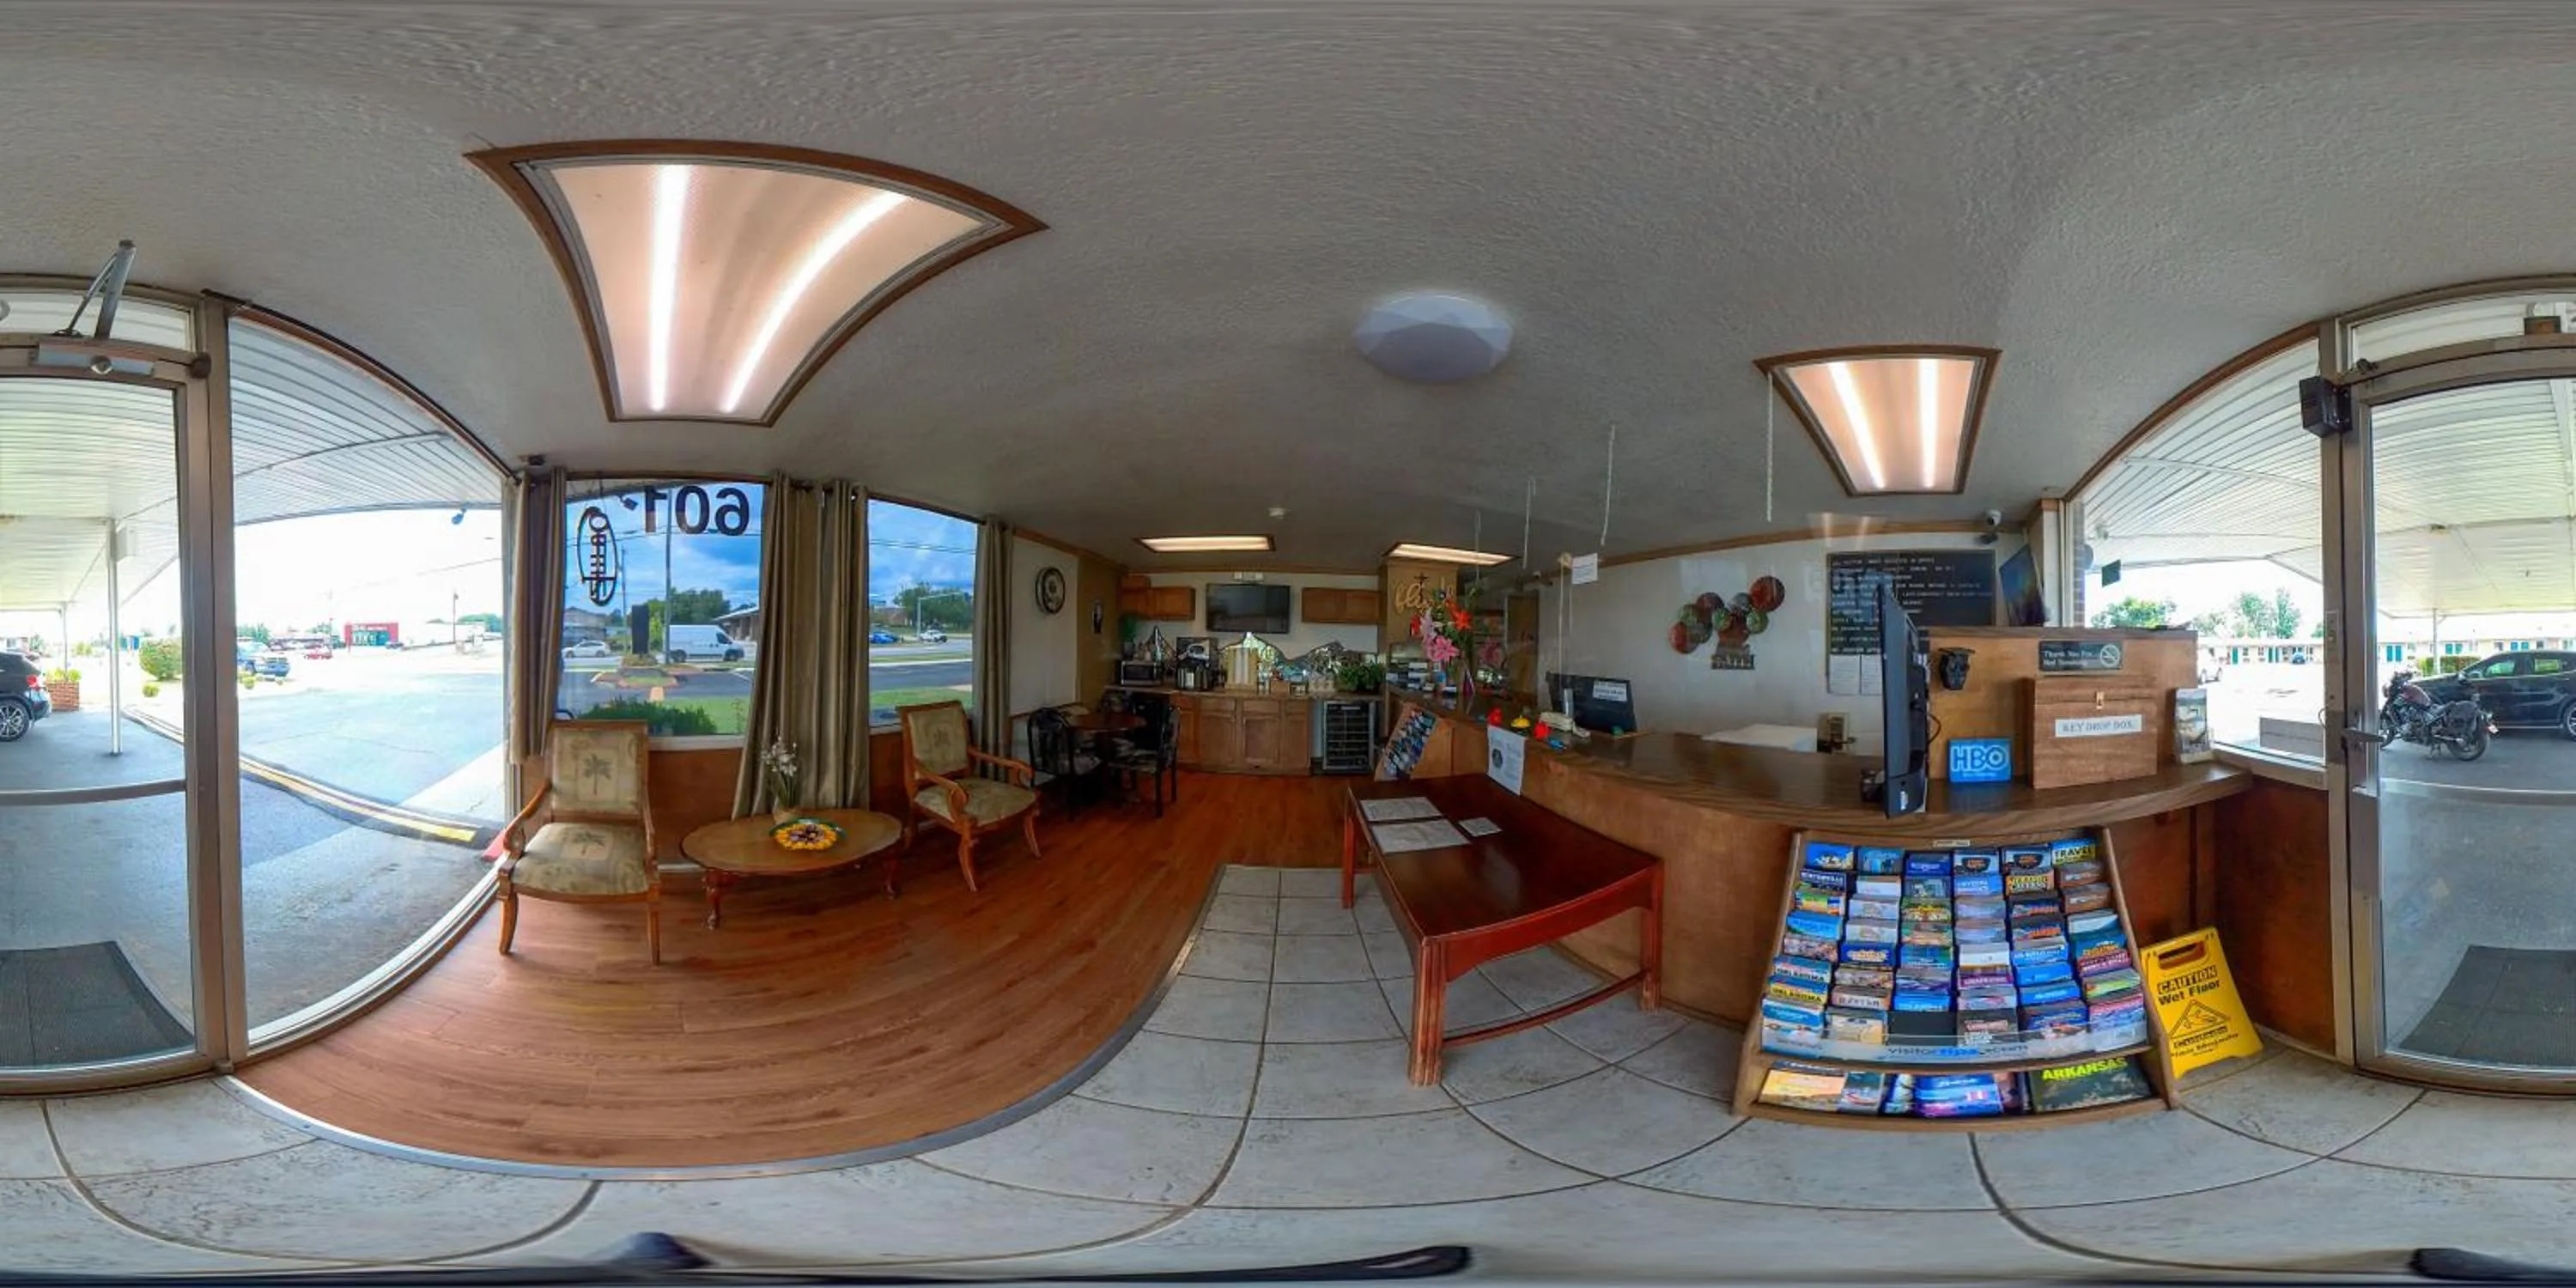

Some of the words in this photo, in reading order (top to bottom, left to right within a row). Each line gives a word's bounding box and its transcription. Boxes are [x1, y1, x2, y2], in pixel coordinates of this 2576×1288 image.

[2063, 721, 2085, 732] KEY
[2113, 719, 2132, 730] BOX
[1951, 744, 2008, 771] HBO
[2157, 965, 2218, 994] CAUTION
[2158, 991, 2185, 1005] Wet
[2190, 980, 2221, 996] Floor
[2042, 1057, 2129, 1080] ARKANSAS
